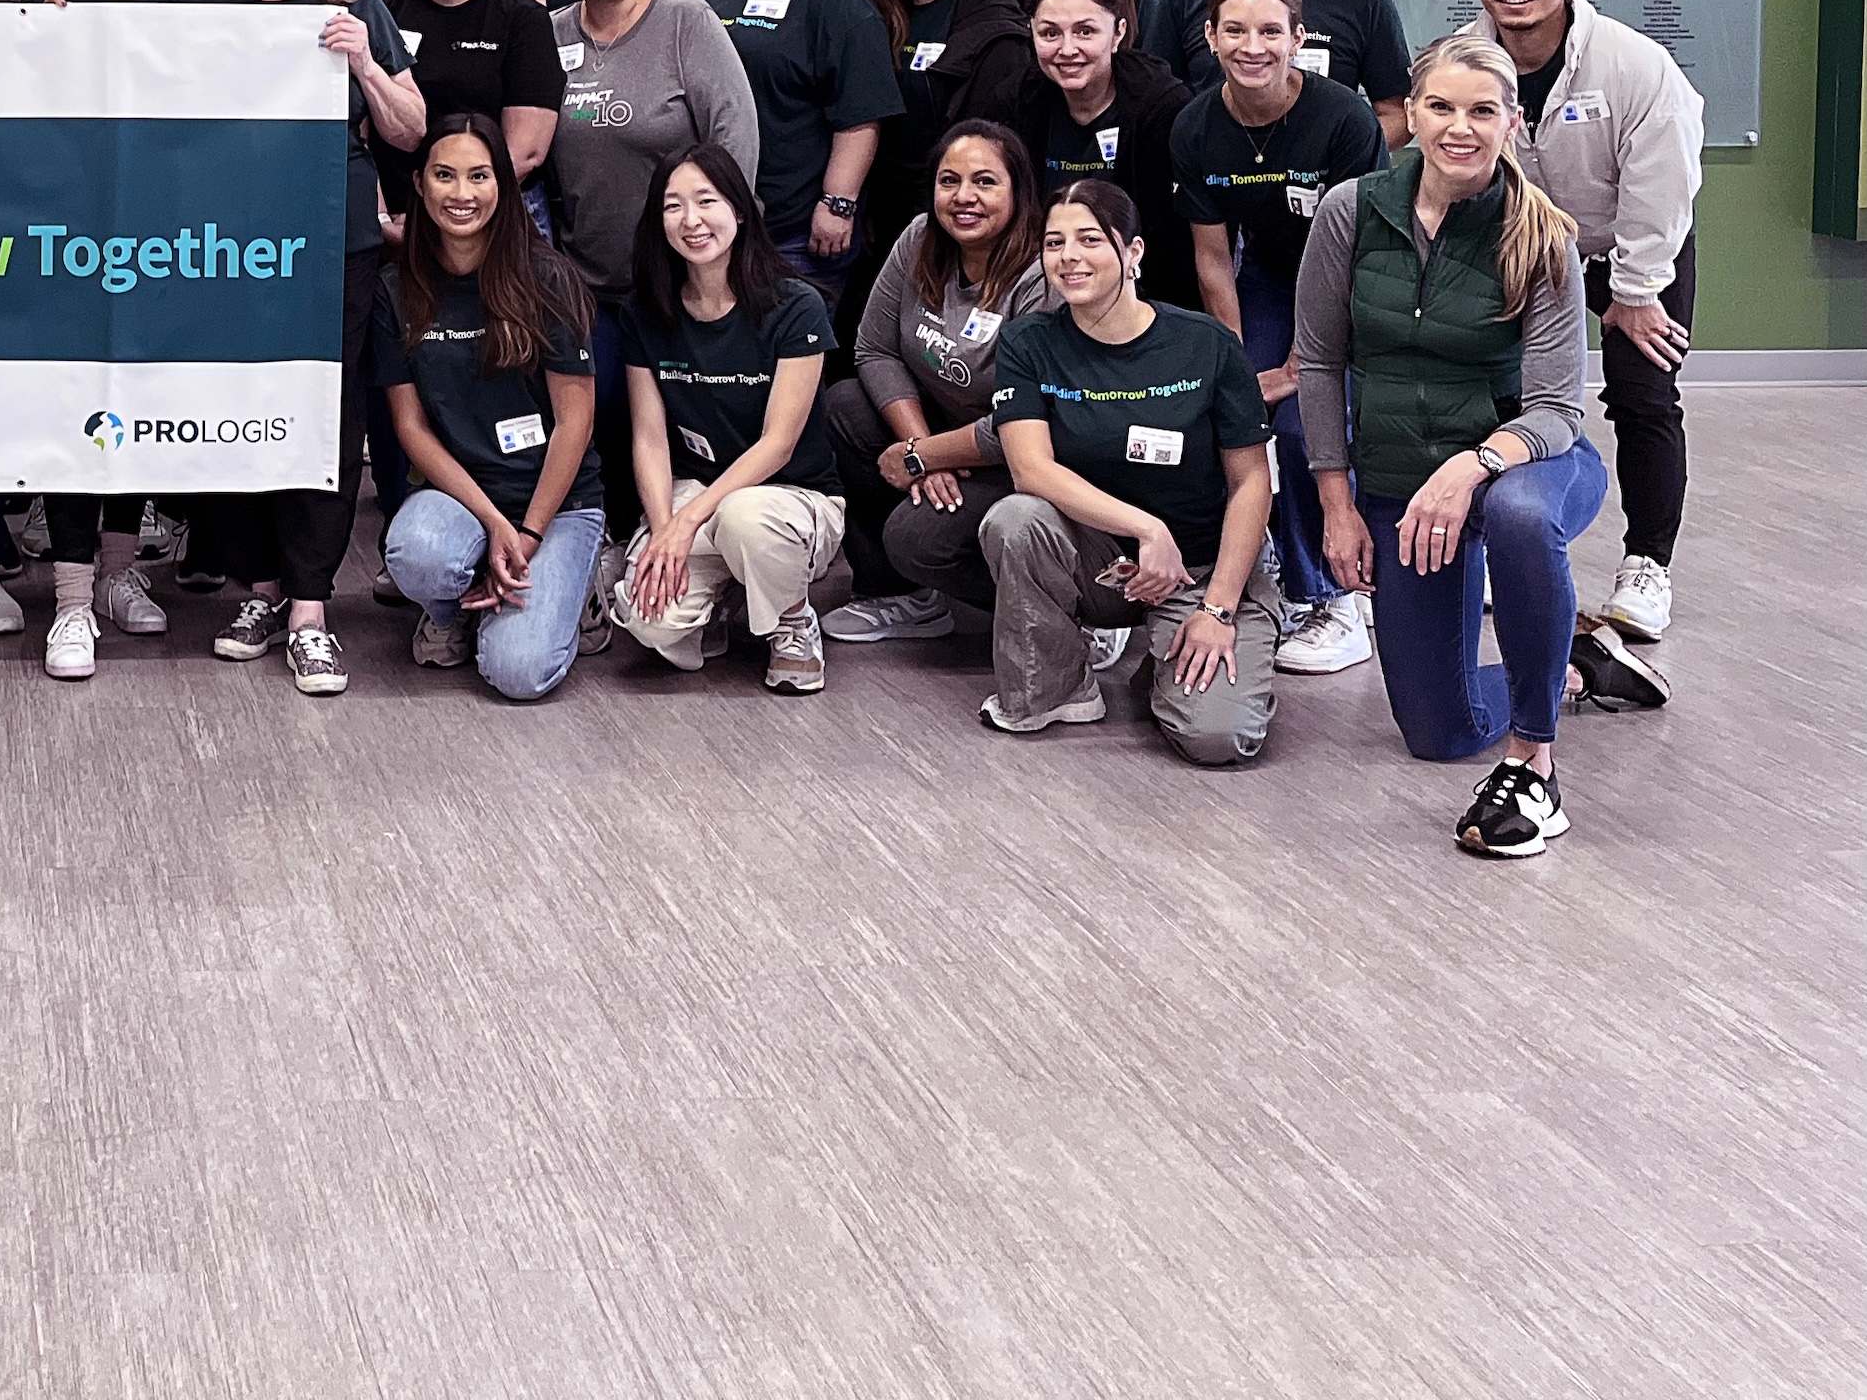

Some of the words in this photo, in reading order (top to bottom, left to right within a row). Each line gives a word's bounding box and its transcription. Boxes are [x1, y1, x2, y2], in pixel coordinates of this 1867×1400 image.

[564, 89, 614, 110] IMPACT
[1231, 172, 1287, 185] Tomorrow
[27, 223, 306, 294] Together
[693, 373, 736, 383] Tomorrow
[1040, 383, 1082, 401] Building
[1083, 388, 1146, 401] Tomorrow
[1148, 378, 1203, 398] Together
